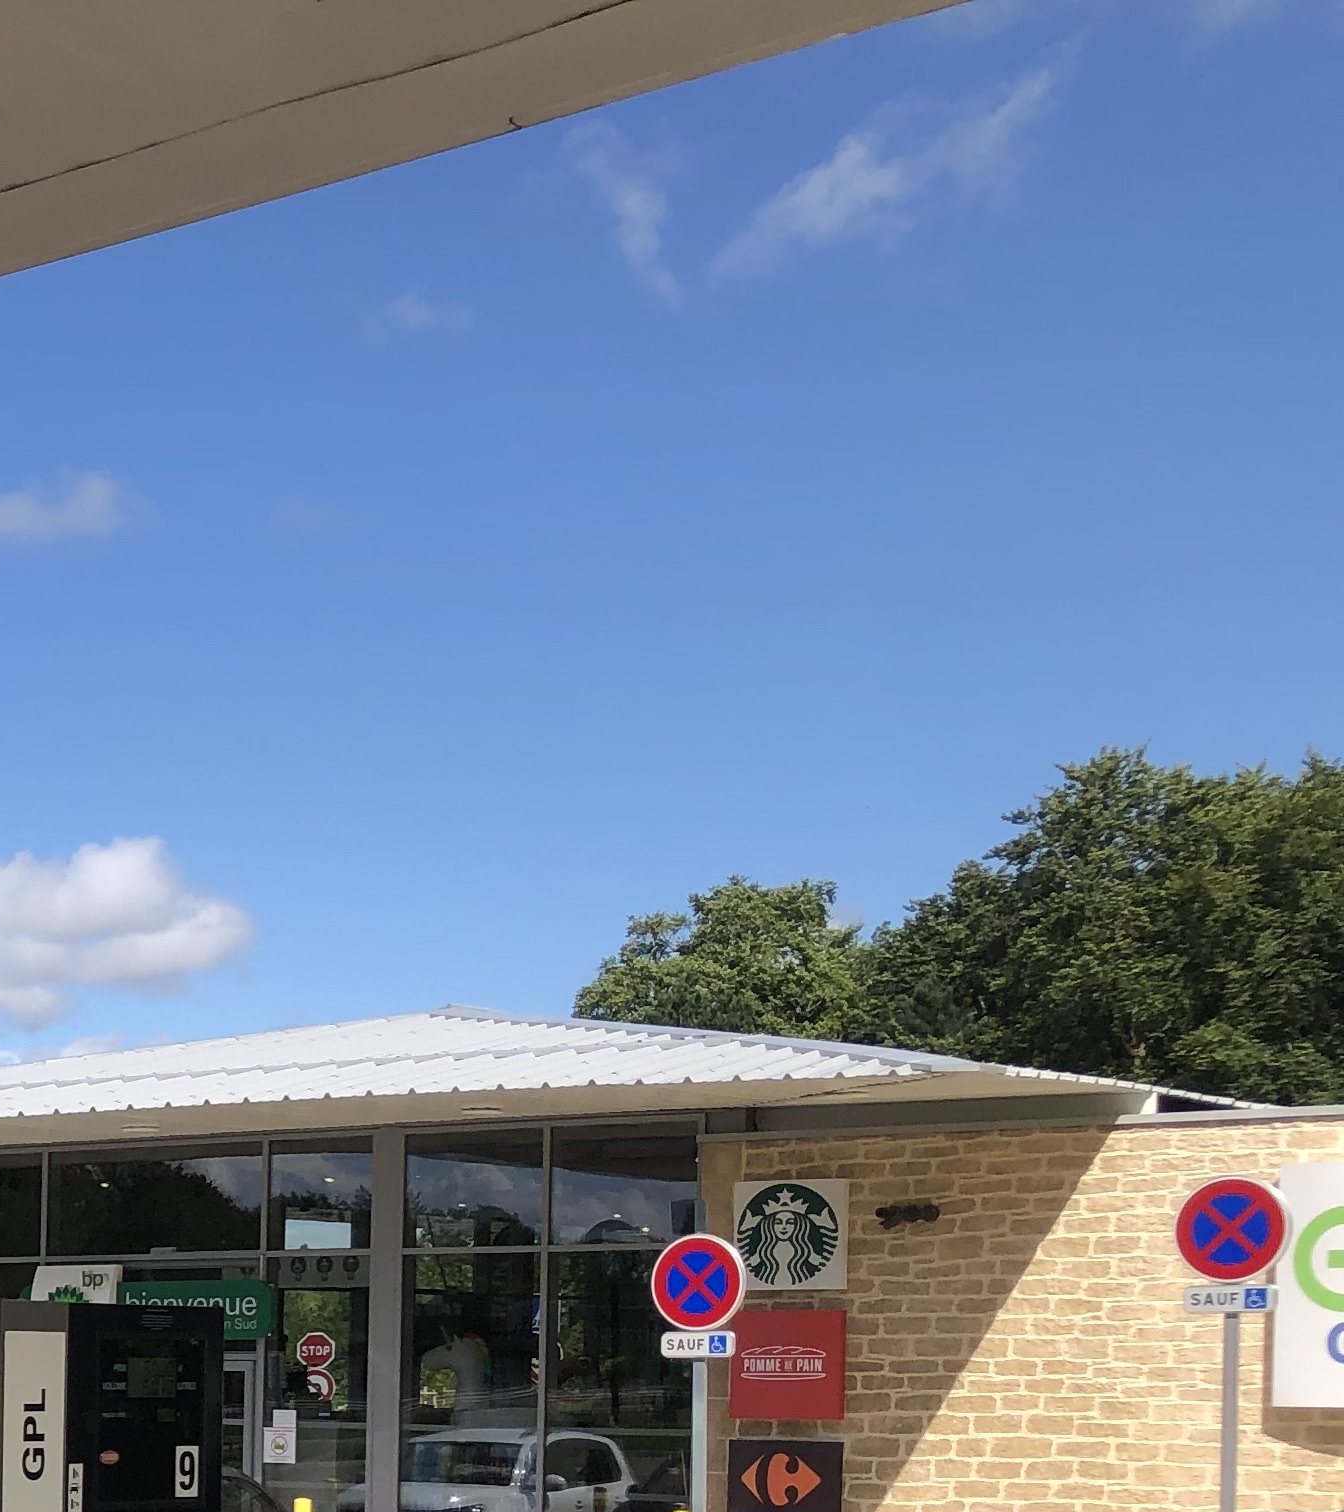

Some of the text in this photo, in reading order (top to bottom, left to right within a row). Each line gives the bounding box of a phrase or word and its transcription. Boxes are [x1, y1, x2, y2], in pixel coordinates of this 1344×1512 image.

[82, 1270, 104, 1289] bp
[1190, 1292, 1242, 1307] SAUF
[234, 1317, 257, 1329] Sud
[301, 1345, 330, 1357] STOP
[667, 1338, 705, 1351] SAUF
[744, 1358, 781, 1372] POMME
[797, 1358, 823, 1372] PAIN
[22, 1388, 47, 1481] GPL
[179, 1451, 195, 1490] 9
